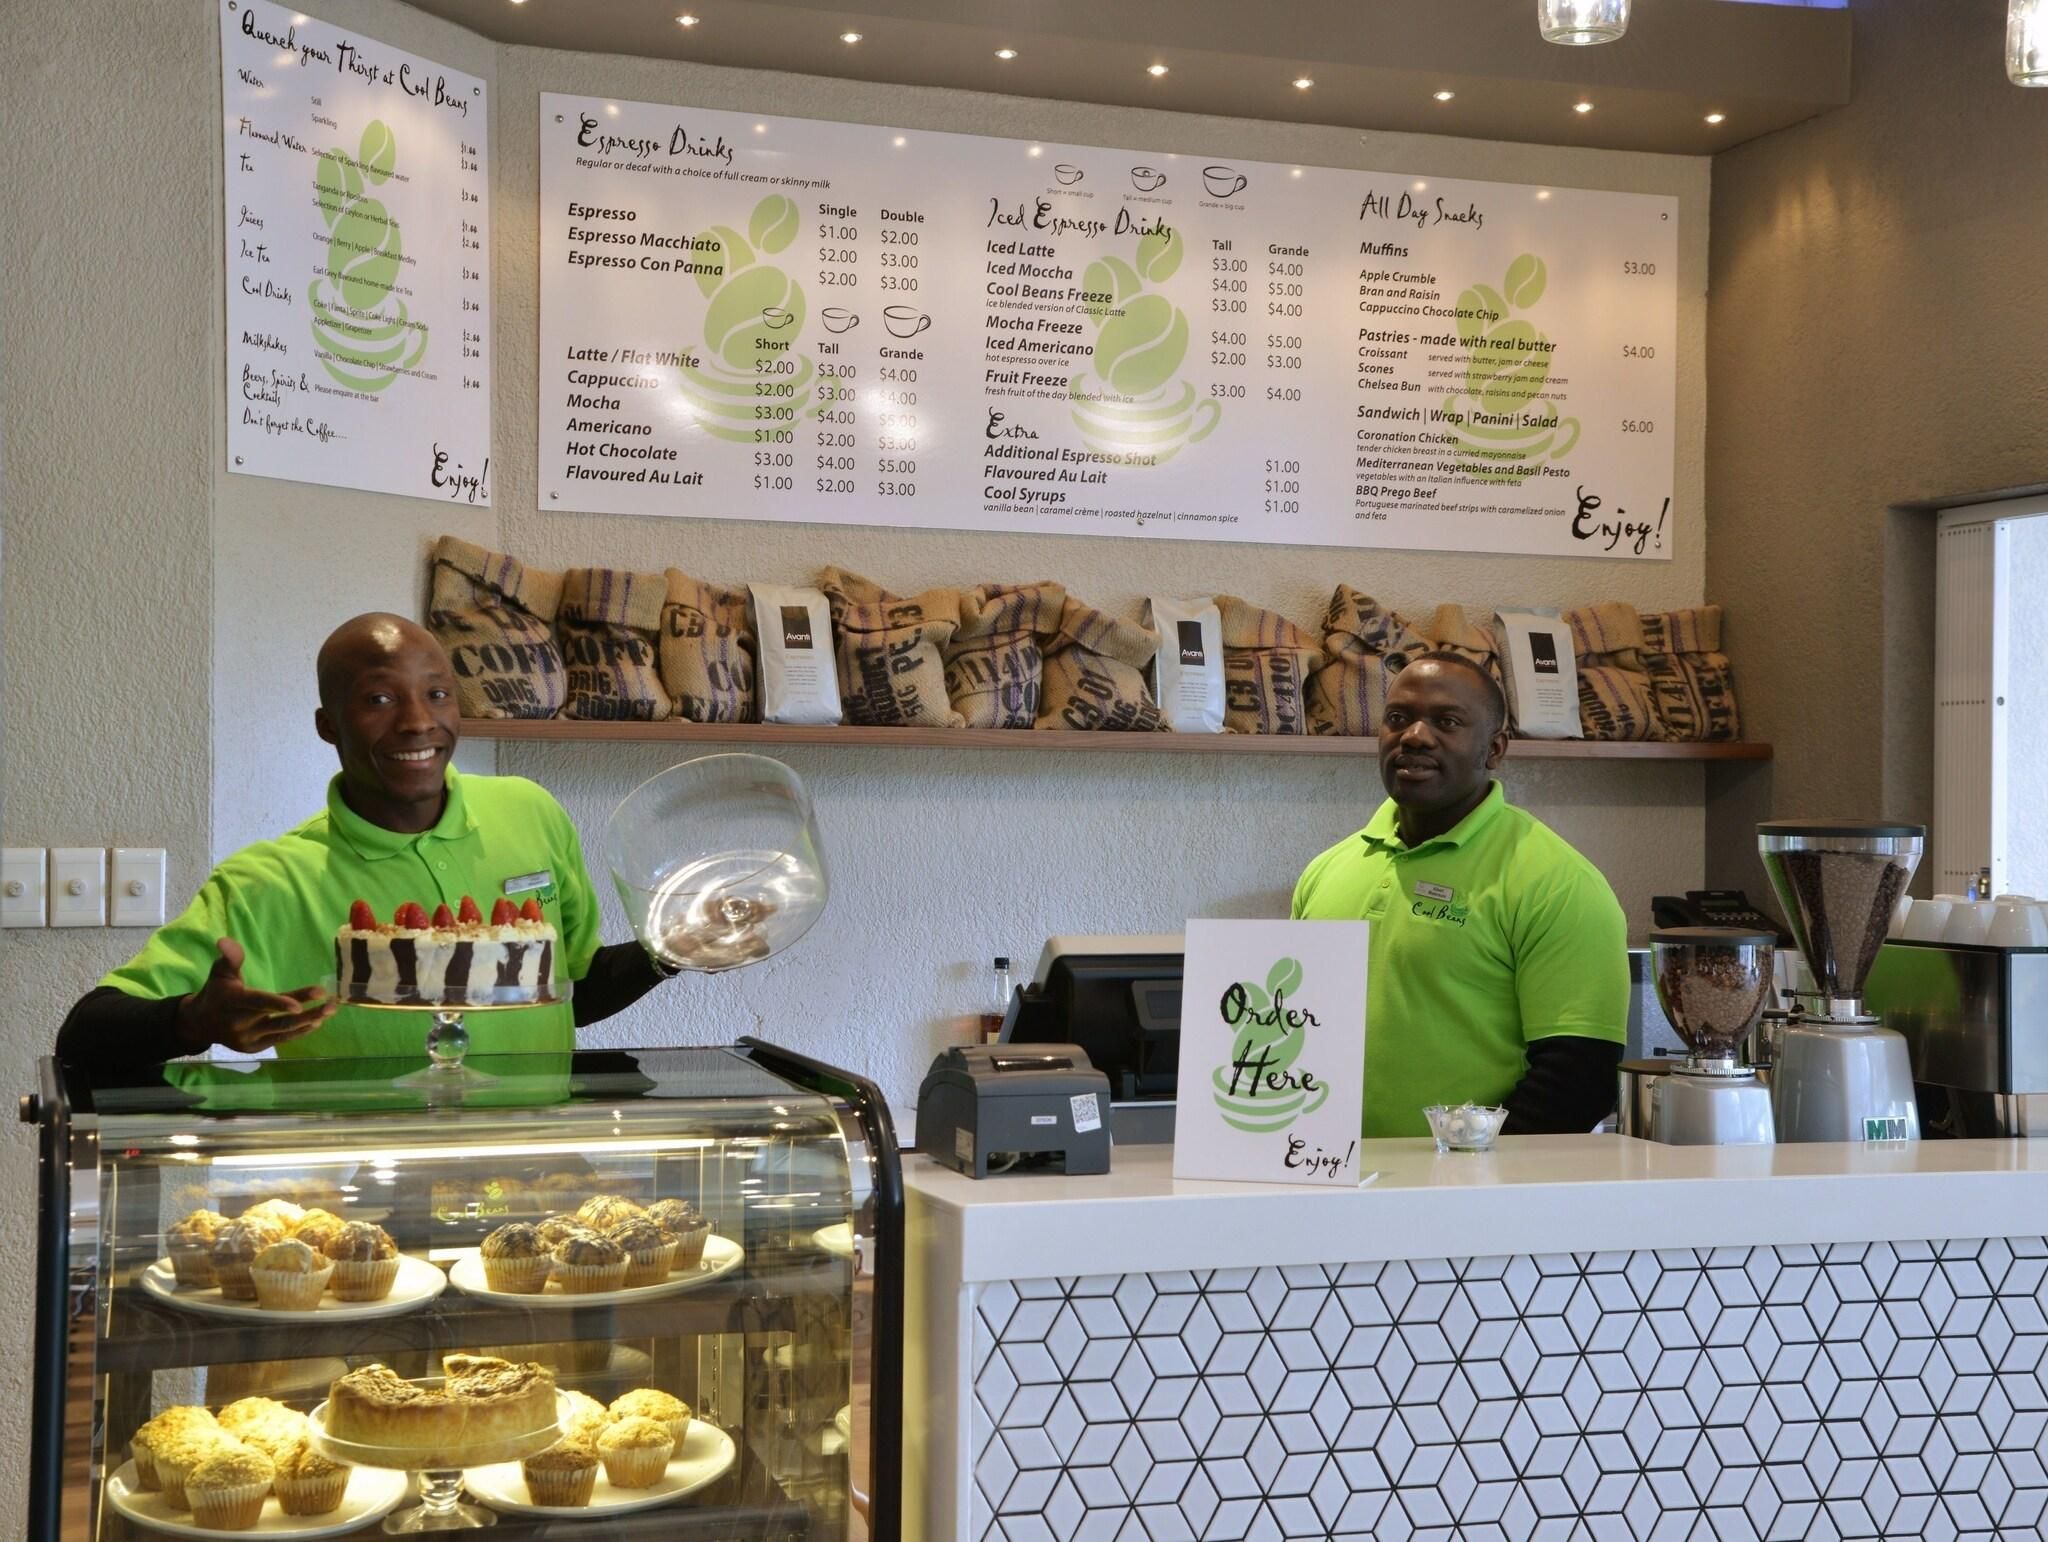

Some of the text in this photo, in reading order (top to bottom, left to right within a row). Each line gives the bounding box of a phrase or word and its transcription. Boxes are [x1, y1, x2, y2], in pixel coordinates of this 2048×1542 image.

[242, 9, 468, 118] Quench your Thirst at Cool Beans
[577, 111, 734, 166] Espresso Drinks
[576, 157, 831, 190] Regular or decaf with a choice of full cream or skinny milk
[568, 202, 637, 222] Espresso
[819, 203, 925, 224] Single Double
[987, 196, 1173, 245] Iced Espresso Drinks
[1360, 190, 1484, 230] All Day Snacks
[568, 226, 721, 253] Espresso Macchiato
[819, 224, 919, 247] $1.00 $2.00
[987, 240, 1055, 258] Iced Latte
[1212, 239, 1309, 258] Tall Grande
[1360, 242, 1409, 258] Muffins
[987, 261, 1073, 281] Iced Moccha
[1212, 258, 1304, 277] $3.00 $4.00
[1624, 261, 1656, 276] $3.00
[986, 282, 1113, 304] Cool Beans Freeze
[986, 299, 1126, 317] ice blended version of Classic Latte
[1359, 302, 1499, 322] Cappuccino Chocolate Chip
[755, 338, 924, 362] Short Tall Grande
[986, 336, 1094, 357] Iced Americano
[1359, 329, 1557, 353] Pastries made with real butter
[568, 346, 701, 369] Latte Flat White
[986, 353, 1070, 368] hot espresso over ice
[1623, 345, 1655, 360] $4.00
[568, 369, 659, 389] Cappuccino
[756, 359, 918, 383] $2.00 $3.00 $4.00
[567, 394, 621, 411] Mocha
[566, 418, 652, 436] Americano
[986, 406, 1040, 440] Extra
[1357, 405, 1558, 429] Sandwich Wrap Panini Salad
[1621, 420, 1654, 433] $6.00
[1357, 429, 1459, 445] Coronation Chicken
[567, 441, 678, 461] Hot Chocolate
[984, 444, 1157, 467] Additional Espresso Shot
[431, 442, 489, 502] Enjoy!
[566, 465, 704, 486] Flavoured Au Lait
[1266, 460, 1300, 474] $1.00
[1356, 457, 1570, 478] Mediterranean Vegetables and Basil Pesto
[984, 485, 1066, 503] Cool Syrups
[1356, 485, 1437, 500] BBQ Prego Beef
[983, 503, 1239, 524] vanilla bean caramel crème roasted hazelnut cinnamon spice
[1355, 511, 1387, 521] and feta
[1572, 485, 1670, 555] Enjoy!
[1220, 981, 1321, 1036] Order
[1227, 1039, 1320, 1097] Here
[1283, 1133, 1355, 1179] Enjoy!
